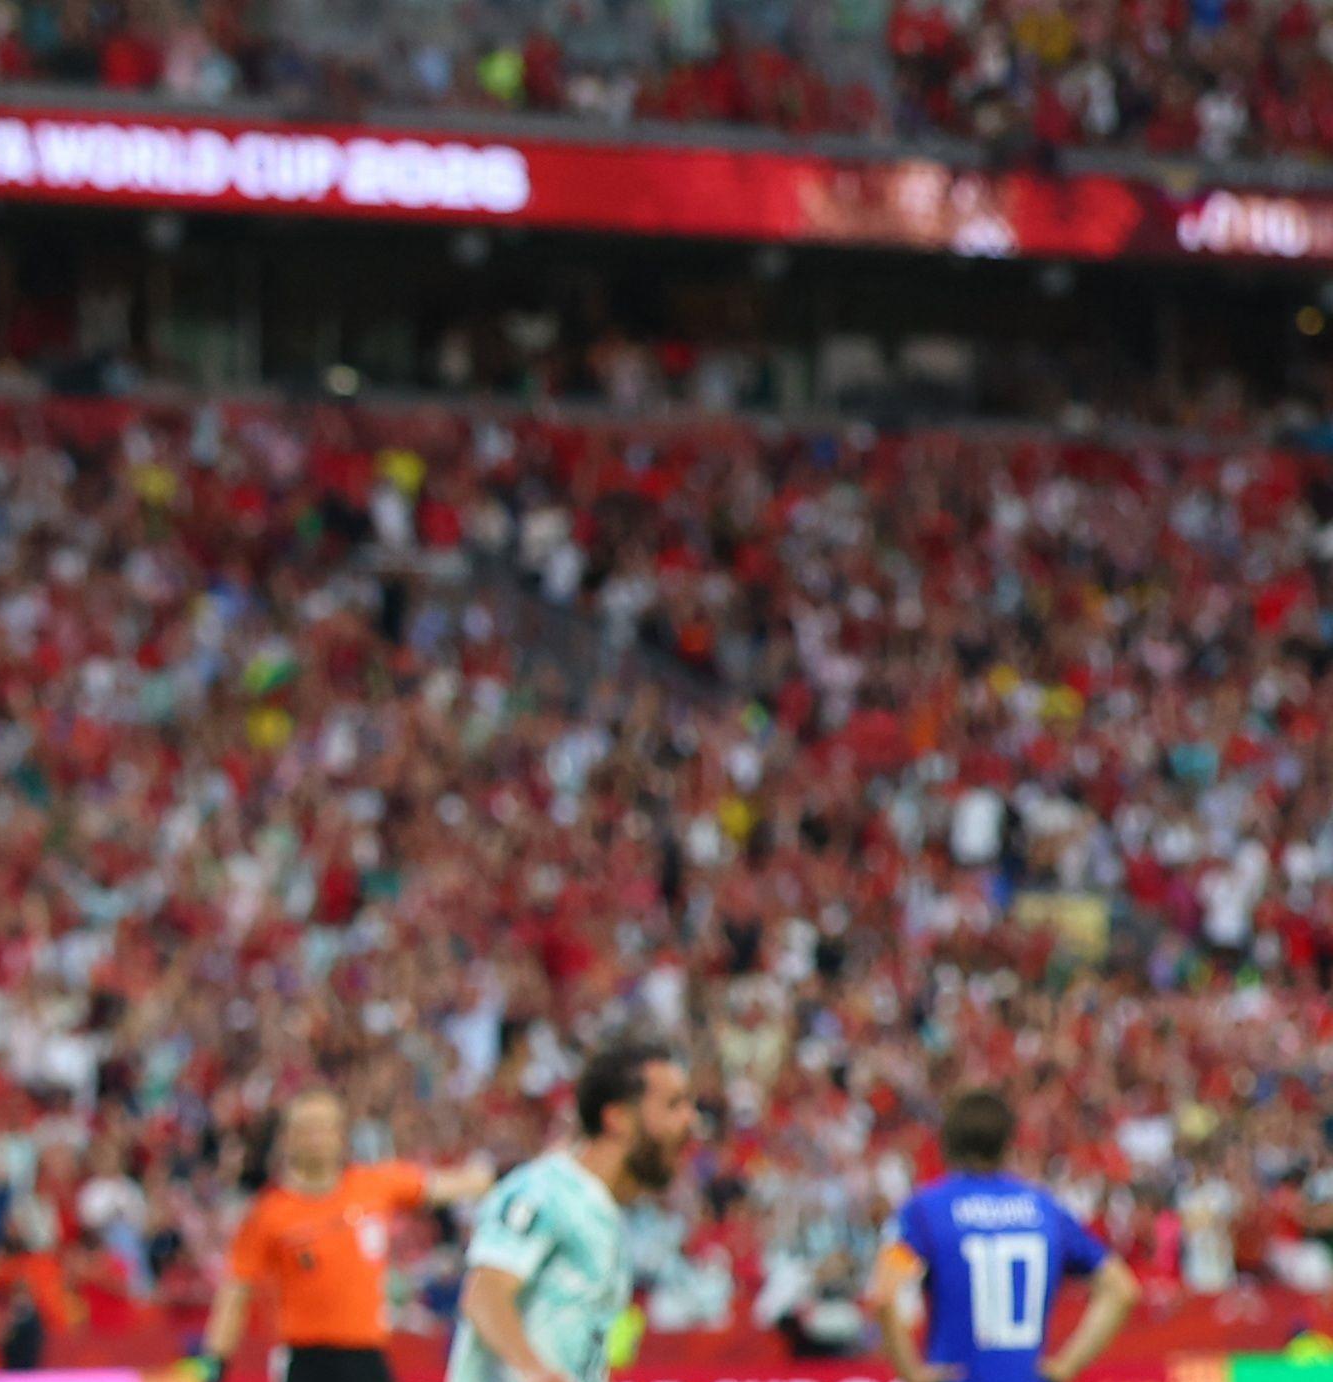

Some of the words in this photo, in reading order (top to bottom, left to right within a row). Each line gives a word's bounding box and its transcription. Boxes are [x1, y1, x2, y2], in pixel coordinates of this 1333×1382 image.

[35, 121, 228, 195] WORLD
[234, 131, 340, 201] CUP
[960, 1233, 1049, 1351] 10
